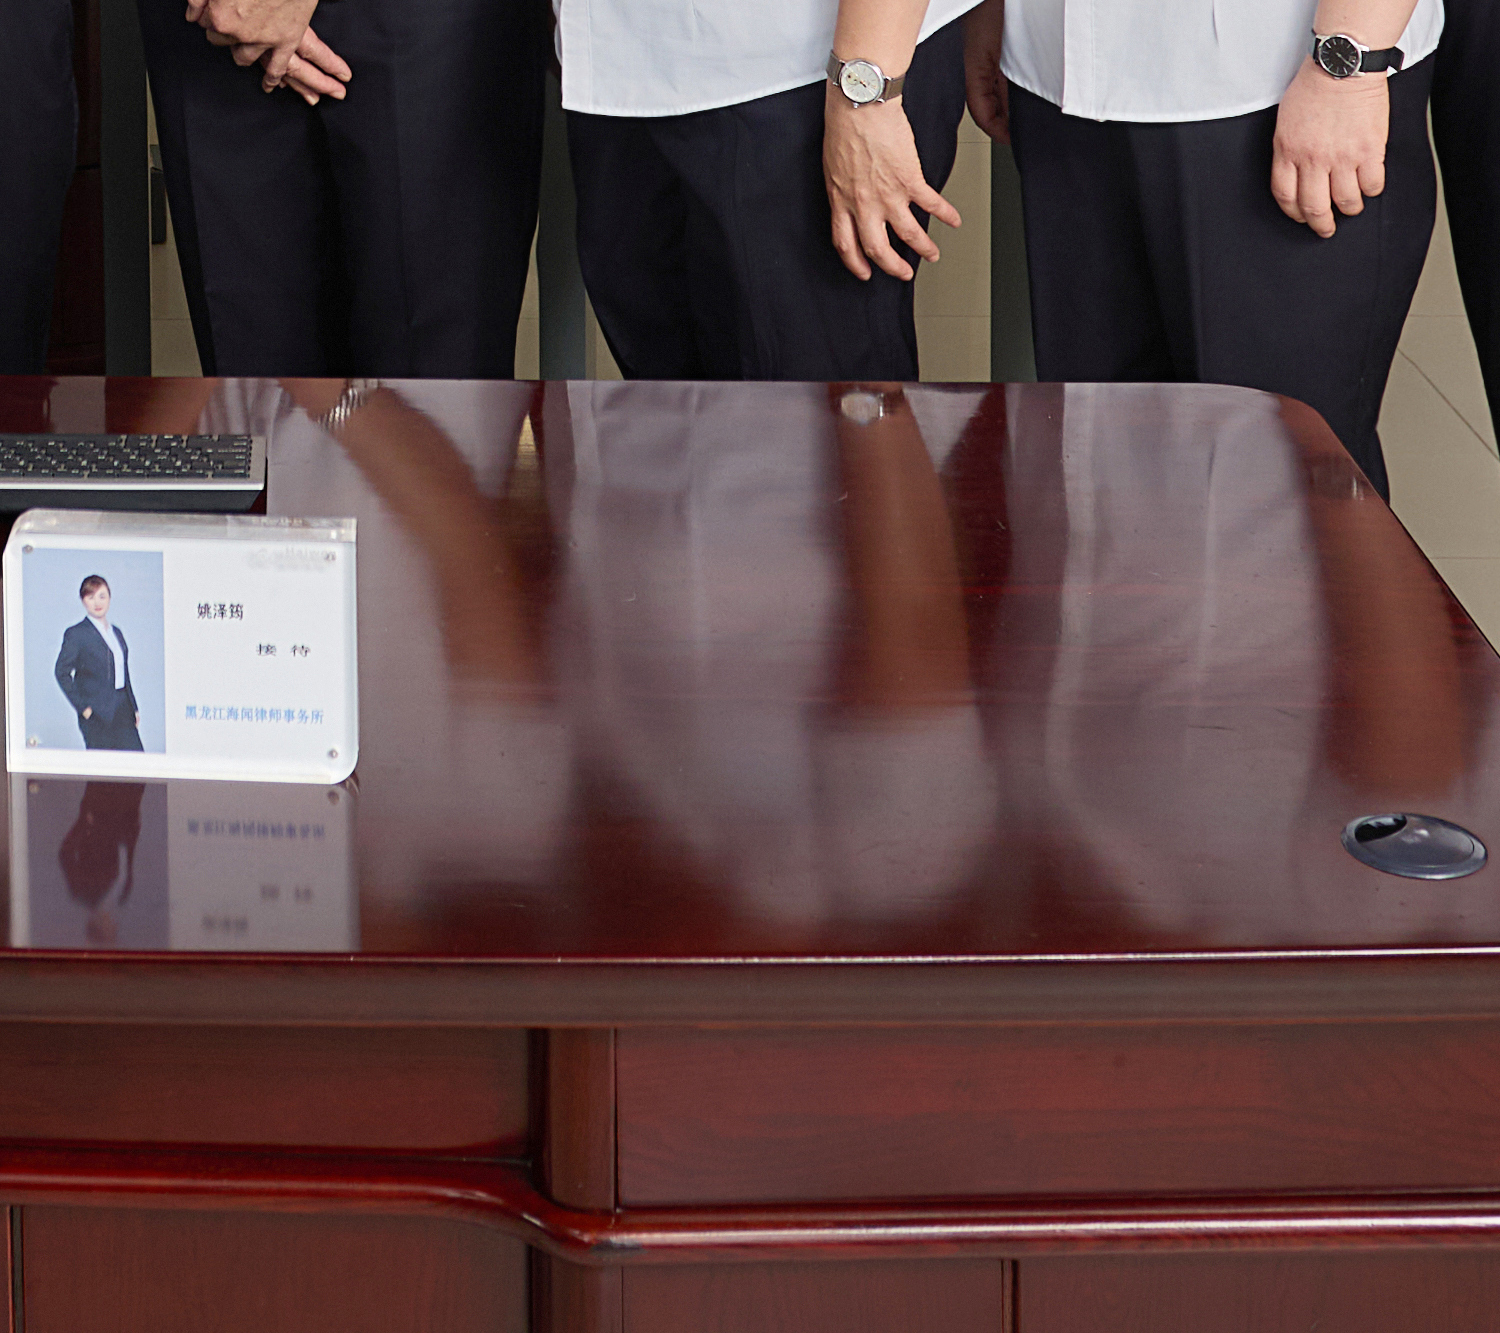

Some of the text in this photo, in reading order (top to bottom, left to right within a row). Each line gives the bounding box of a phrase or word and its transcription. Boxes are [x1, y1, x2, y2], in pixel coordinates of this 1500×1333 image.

[185, 704, 324, 724] 黑龙江海闻律师事务所
